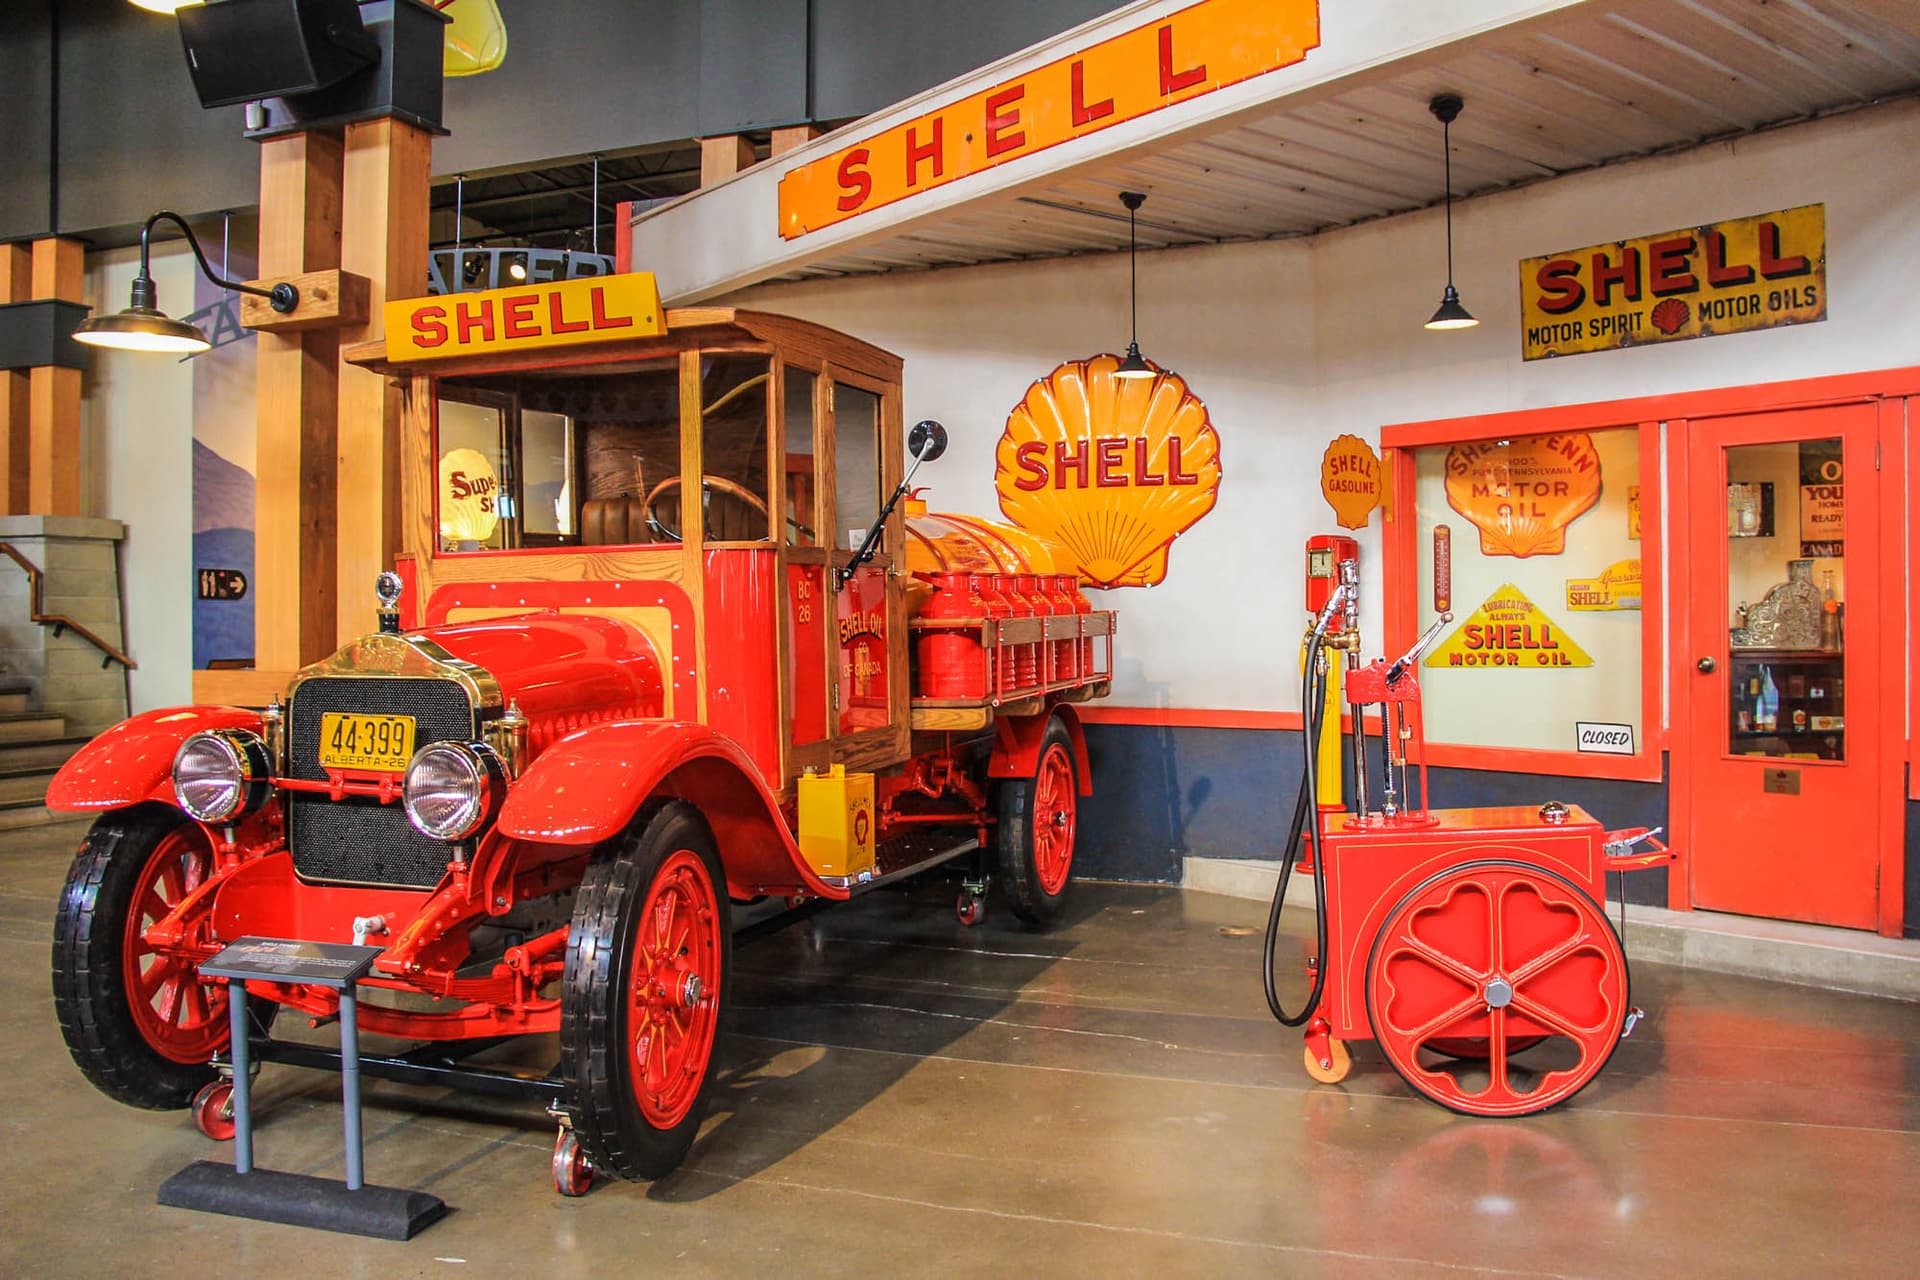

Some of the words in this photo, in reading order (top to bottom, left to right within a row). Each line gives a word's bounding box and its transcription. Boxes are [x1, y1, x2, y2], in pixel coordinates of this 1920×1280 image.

[837, 24, 1207, 212] SHELL
[1536, 221, 1811, 314] SHELL
[411, 287, 633, 348] SHELL
[1528, 321, 1582, 346] MOTOR
[1589, 312, 1643, 337] SPIRIT
[1699, 294, 1761, 321] MOTOR
[1769, 286, 1817, 311] OILS
[1014, 436, 1198, 491] SHELL
[1451, 438, 1512, 476] SHE
[1532, 434, 1593, 473] ENN
[1330, 455, 1371, 478] SHELL
[450, 471, 497, 500] Supe
[1329, 479, 1374, 494] GASOLINE
[1472, 482, 1569, 498] MOTOR
[1497, 503, 1546, 518] OIL
[798, 581, 811, 599] BC
[1570, 592, 1613, 606] SHELL
[798, 605, 811, 623] 26
[1483, 600, 1533, 613] LUBRICATING
[1490, 612, 1526, 621] ALWAYS
[840, 611, 868, 644] SHELL
[870, 612, 883, 640] OIL
[1464, 624, 1558, 649] SHELL
[1450, 652, 1519, 665] MOTOR
[1536, 652, 1571, 665] OIL
[855, 661, 882, 677] CANADA
[1582, 730, 1629, 746] CLOSED
